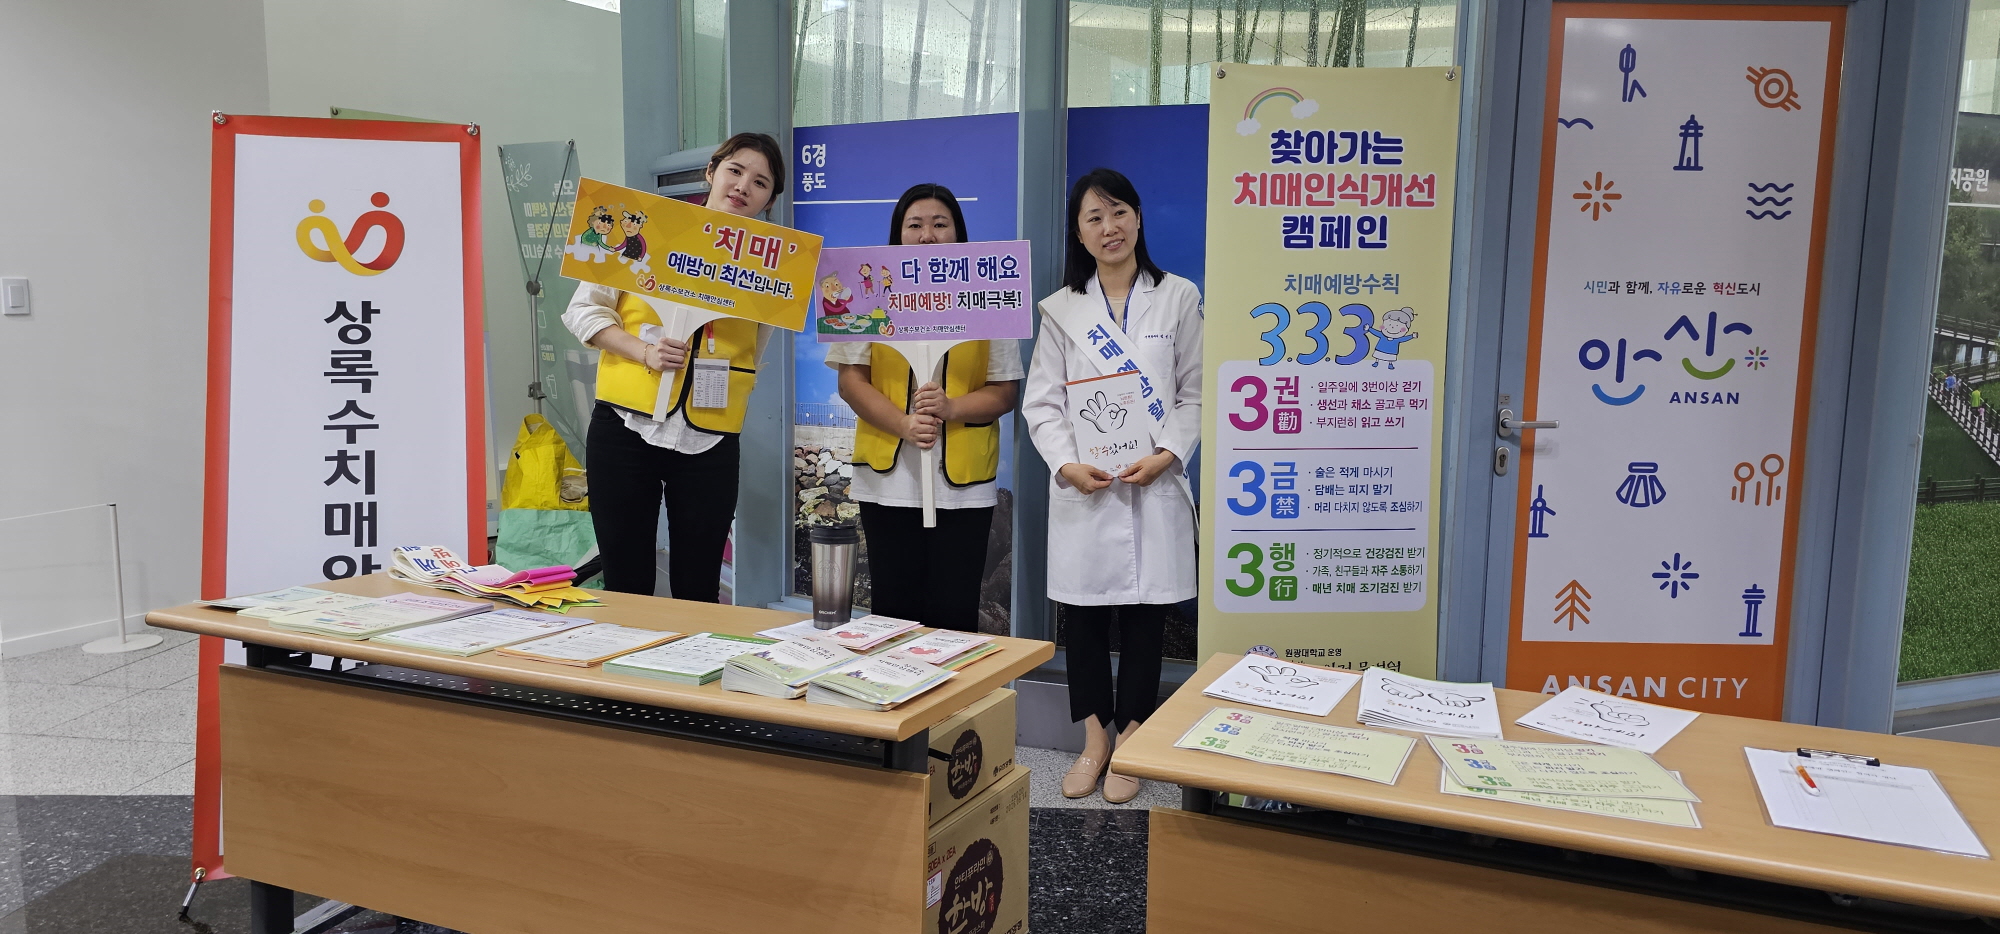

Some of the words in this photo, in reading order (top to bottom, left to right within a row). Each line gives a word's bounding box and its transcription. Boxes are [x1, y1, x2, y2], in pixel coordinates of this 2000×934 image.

[801, 144, 826, 168] 6경
[1271, 129, 1403, 165] 찾아가는
[801, 172, 826, 192] 풍도
[1234, 172, 1436, 207] 치매인식개선
[1282, 215, 1388, 249] 캠페인
[668, 252, 716, 280] 예방이
[719, 264, 793, 298] 최선입니다.
[901, 258, 921, 284] 다
[928, 257, 969, 284] 함께
[976, 255, 1020, 282] 해요
[1284, 274, 1399, 295] 치매예방수칙
[1583, 281, 1620, 295] 시민과
[1625, 281, 1653, 295] 함께,
[1657, 282, 1707, 296] 자유로운
[1713, 282, 1761, 296] 혁신도시
[888, 292, 952, 312] 치매예방!
[957, 290, 1022, 310] 치매극복!
[1087, 323, 1125, 361] 치매
[1317, 381, 1359, 394] 일주일에
[1361, 380, 1399, 393] 3번이상
[1402, 380, 1422, 393] 걷기
[1228, 375, 1269, 431] 3
[1273, 376, 1300, 406] 권
[1317, 399, 1348, 411] 생선과
[1351, 399, 1372, 411] 채소
[1375, 399, 1405, 411] 골고루
[1409, 398, 1428, 411] 먹기
[1669, 391, 1740, 405] ANSAN
[1316, 416, 1357, 429] 부지런히
[1361, 416, 1381, 429] 읽고
[1384, 416, 1405, 429] 쓰기
[1314, 466, 1335, 479] 술은
[1339, 466, 1360, 479] 적게
[1363, 466, 1394, 479] 마시기
[1226, 460, 1267, 516] 3
[1270, 461, 1299, 491] 금
[1314, 484, 1345, 496] 담배는
[1348, 484, 1369, 496] 피지
[1372, 484, 1393, 496] 말기
[1275, 497, 1296, 516] 禁
[1314, 501, 1331, 514] 머리
[1334, 501, 1360, 513] 다치지
[1362, 501, 1388, 514] 않도록
[1390, 500, 1423, 513] 조심하기
[1313, 547, 1362, 560] 정기적으로
[1365, 547, 1404, 560] 건강검진
[1407, 547, 1426, 559] 받기
[1225, 542, 1265, 598] 3
[1269, 541, 1296, 573] 행
[1312, 565, 1332, 578] 가족,
[1335, 564, 1369, 577] 친구들과
[1371, 564, 1388, 577] 자주
[1391, 564, 1423, 577] 소통하기
[1274, 578, 1294, 598] 行
[1312, 582, 1333, 595] 매년
[1336, 582, 1356, 595] 치매
[1359, 582, 1399, 595] 조기검진
[1403, 581, 1422, 594] 받기
[1285, 648, 1326, 658] 원광대학교
[1327, 648, 1342, 657] 운영
[1541, 675, 1667, 698] ANSAN
[1678, 677, 1749, 699] CITY
[955, 856, 986, 890] 안티푸라민
